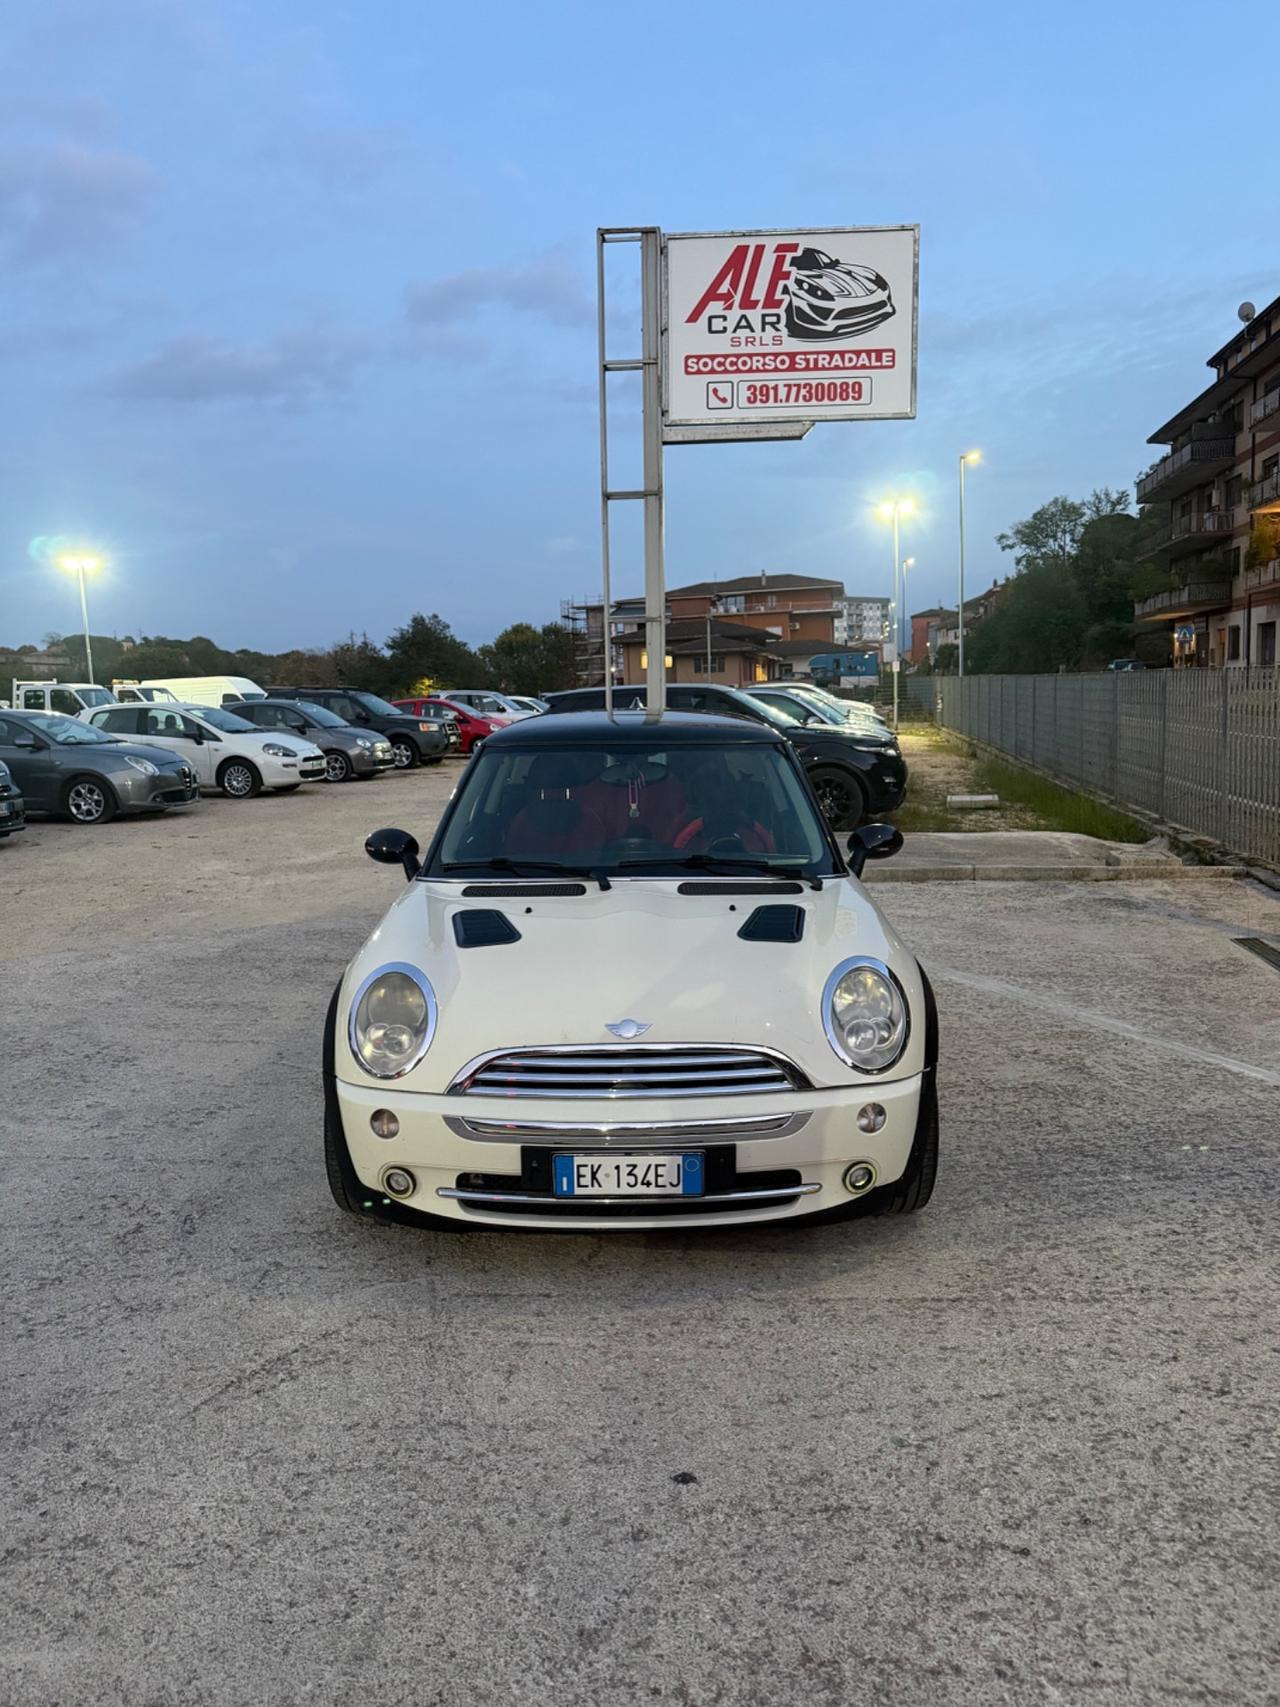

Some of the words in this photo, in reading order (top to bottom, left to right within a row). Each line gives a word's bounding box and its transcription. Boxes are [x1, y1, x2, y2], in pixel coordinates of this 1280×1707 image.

[684, 243, 799, 323] ALE
[707, 314, 781, 334] CAR
[730, 335, 783, 347] SRLS
[687, 355, 789, 372] SOCCORSO
[795, 351, 893, 368] STRADALE
[746, 381, 863, 404] 391.7730089
[576, 1164, 602, 1188] EK
[614, 1163, 681, 1188] 134EJ
